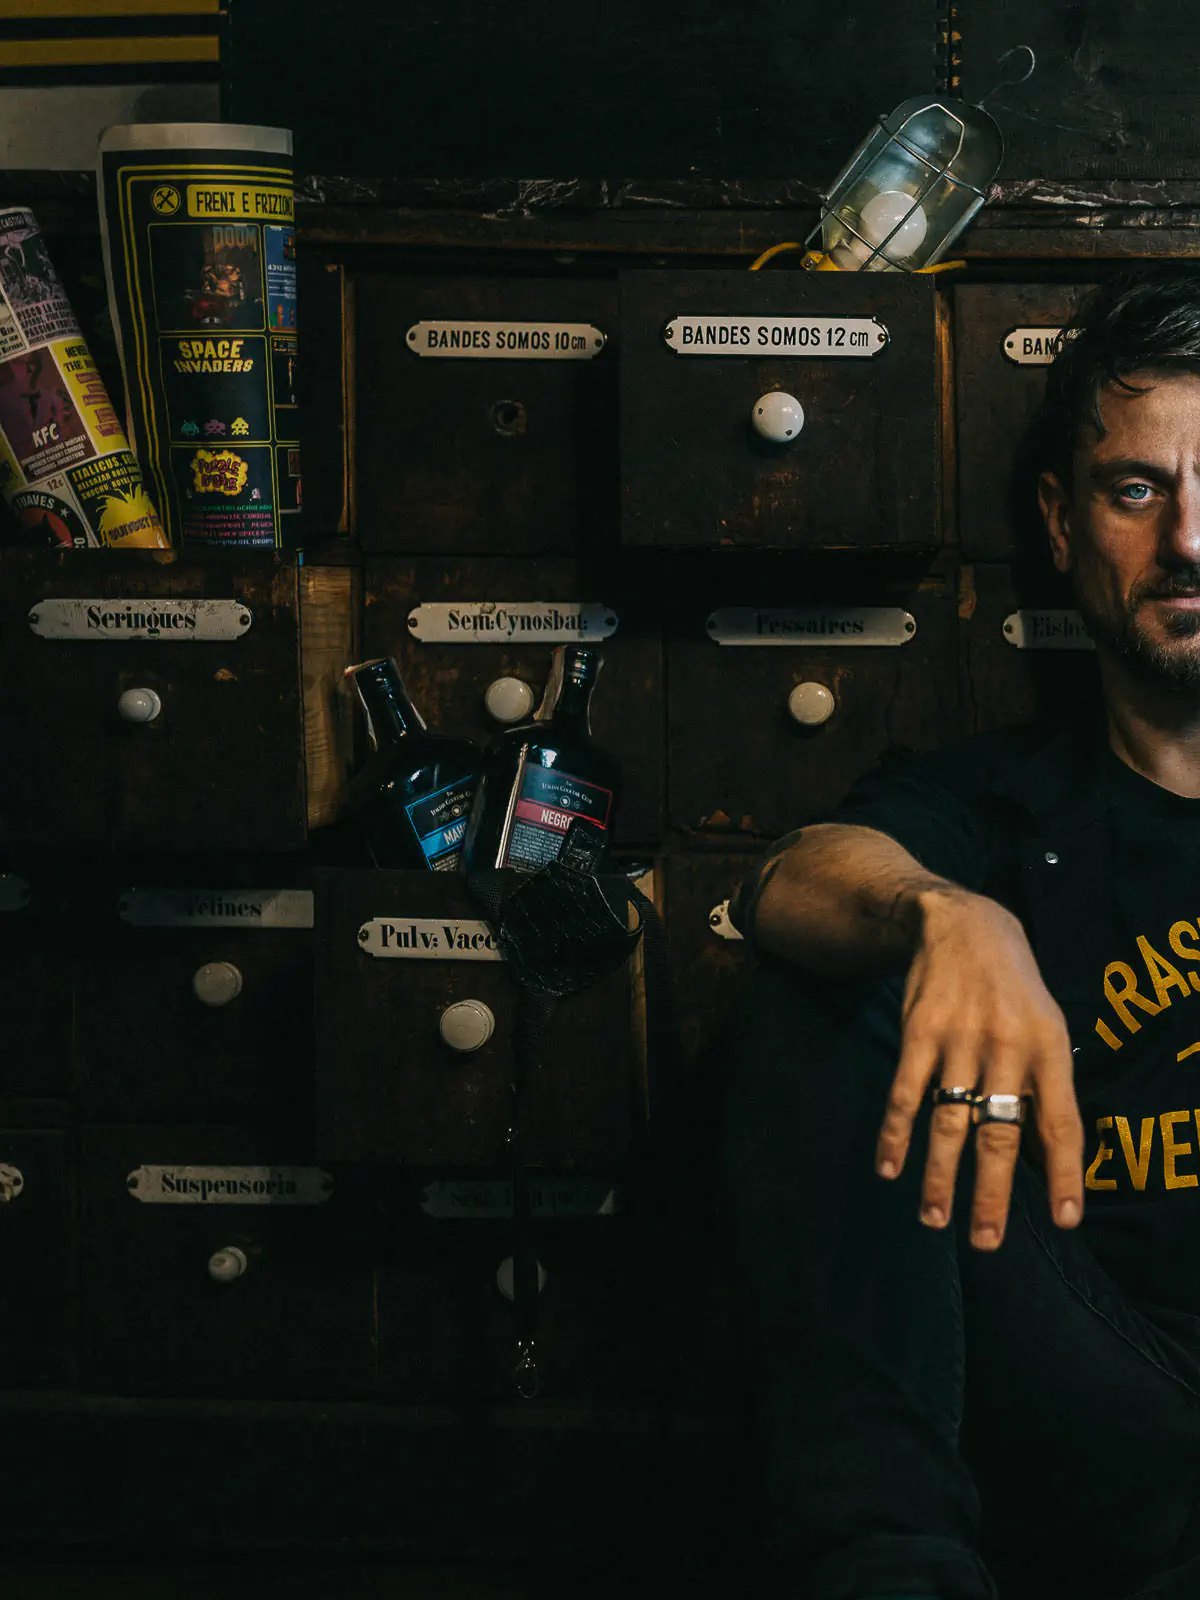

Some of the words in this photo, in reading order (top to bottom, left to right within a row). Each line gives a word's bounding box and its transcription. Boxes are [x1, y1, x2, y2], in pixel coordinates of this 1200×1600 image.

[195, 191, 236, 213] FRENI
[242, 192, 250, 213] E
[212, 226, 258, 254] DOOM
[427, 329, 491, 349] BANDES
[495, 331, 551, 350] SOMOS
[682, 325, 751, 346] BANDES
[757, 326, 822, 347] SOMOS
[177, 339, 245, 359] SPACE
[172, 358, 254, 374] INVADERS
[31, 423, 60, 449] KFC
[86, 605, 198, 638] Seringues
[443, 821, 467, 846] MAH
[161, 1172, 298, 1201] Suspensoria
